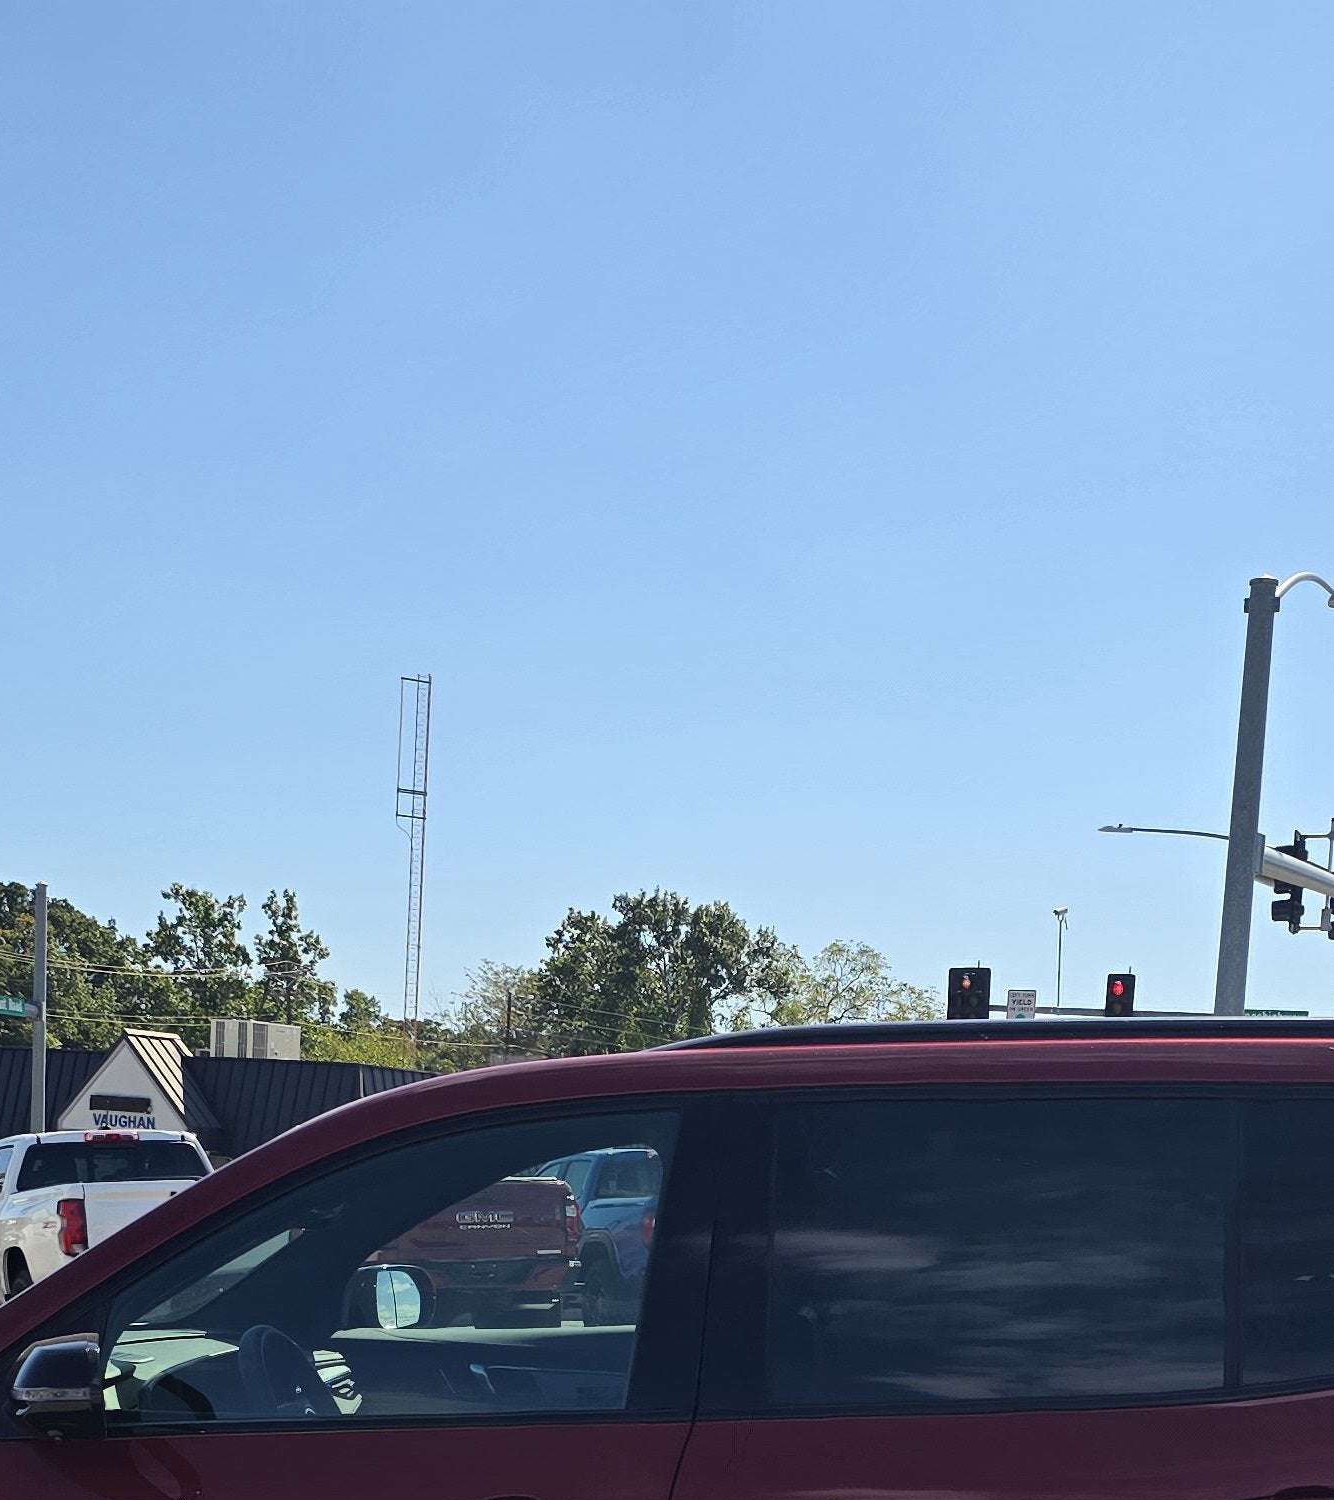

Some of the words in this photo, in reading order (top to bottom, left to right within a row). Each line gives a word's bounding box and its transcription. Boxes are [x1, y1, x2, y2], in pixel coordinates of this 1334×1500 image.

[92, 1112, 156, 1130] VAUGHAN
[455, 1210, 514, 1223] GMC
[459, 1223, 511, 1231] CANYON
